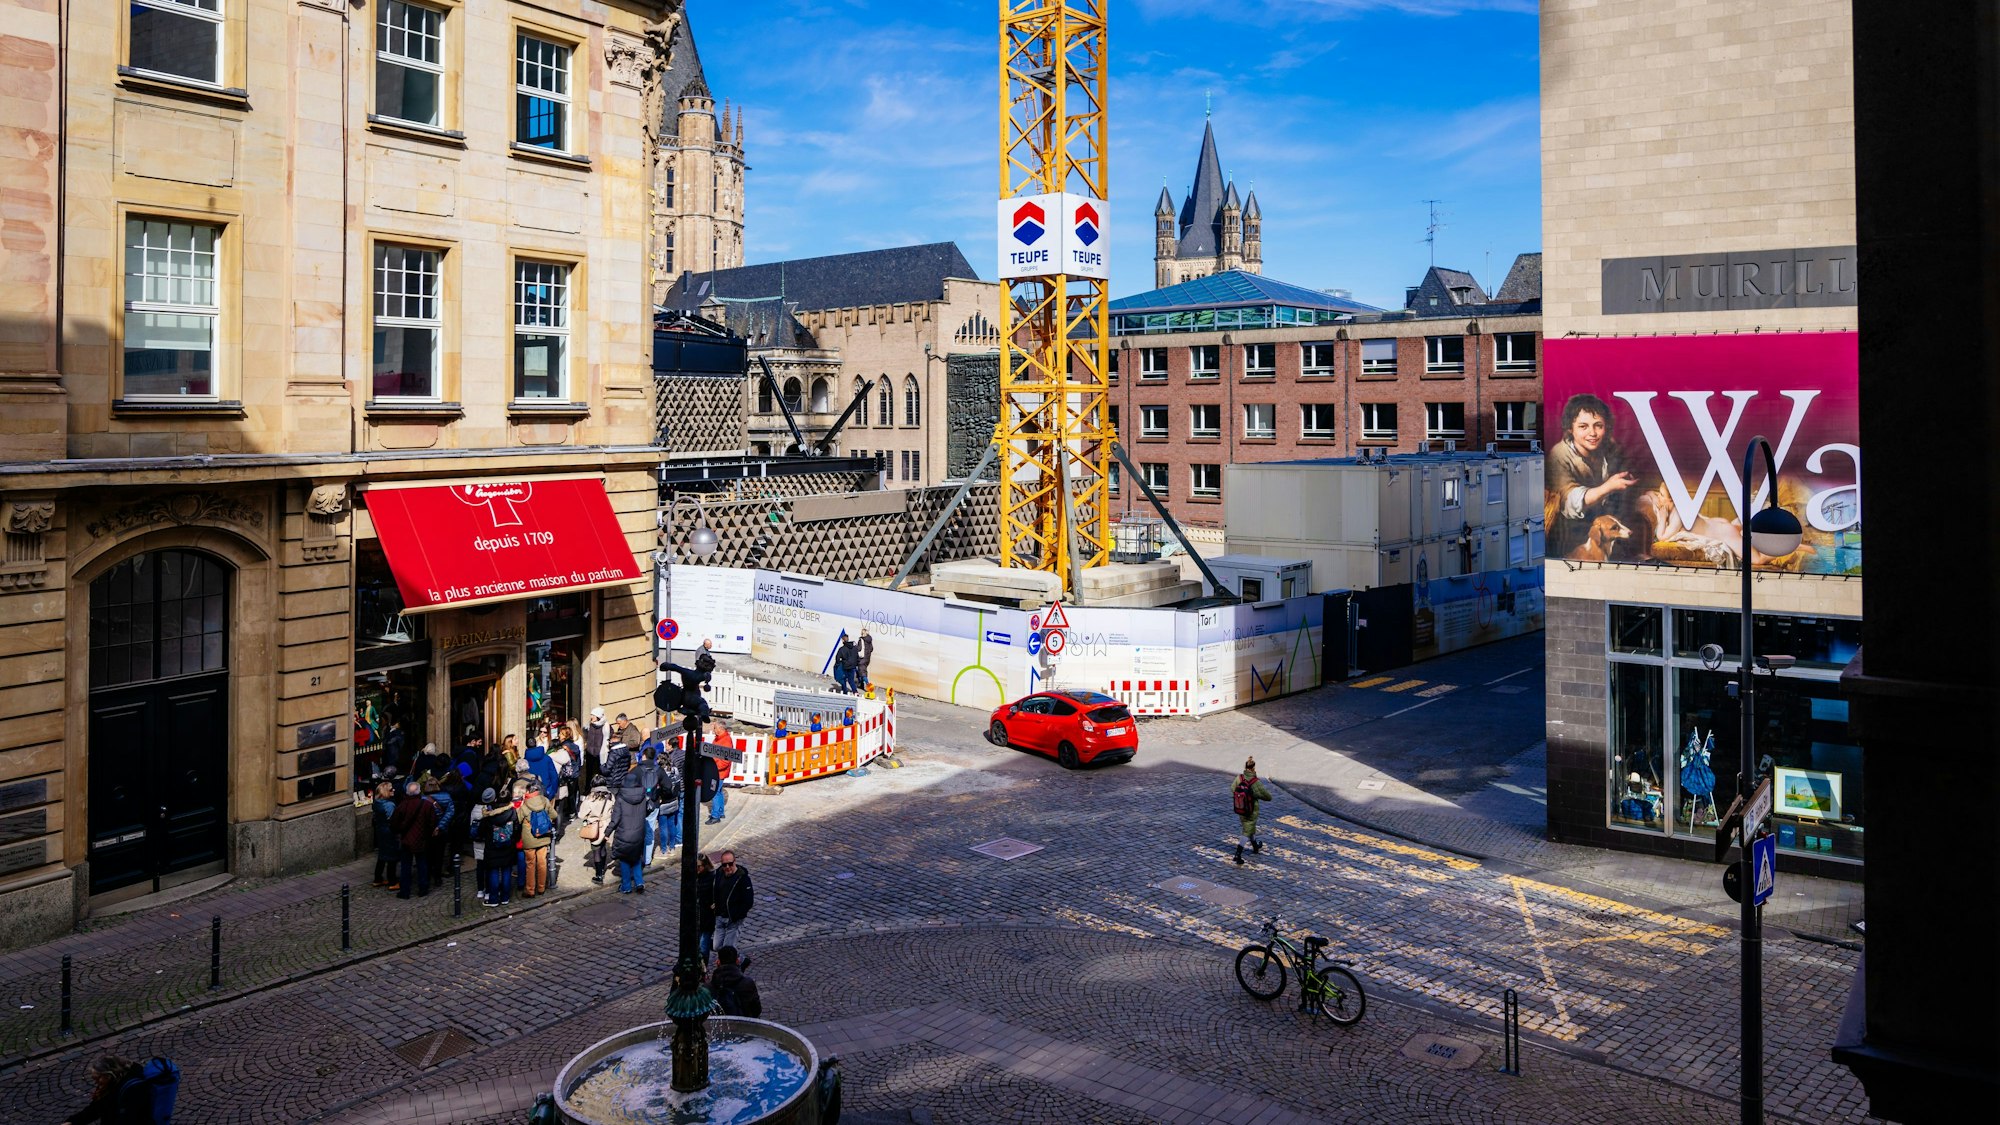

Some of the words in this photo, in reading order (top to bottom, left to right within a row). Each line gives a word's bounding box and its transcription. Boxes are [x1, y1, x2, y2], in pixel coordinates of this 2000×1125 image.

[1010, 249, 1049, 265] TEUPE
[1072, 250, 1102, 265] TEUPE
[1613, 390, 1861, 532] Wa
[474, 534, 520, 552] depuis
[524, 531, 554, 546] 1709
[428, 589, 441, 602] la
[444, 585, 471, 602] plus
[474, 581, 526, 596] ancienne
[529, 574, 568, 588] maison
[570, 571, 585, 583] du
[588, 567, 624, 584] parfum
[758, 583, 775, 592] AUF
[776, 586, 789, 596] EIN
[791, 588, 808, 599] ORT
[757, 593, 785, 605] UNTER
[786, 599, 806, 609] UNS.
[757, 603, 767, 613] IM
[768, 605, 797, 619] DIALOG
[799, 609, 821, 623] ÜBER
[859, 608, 905, 627] MIQUA
[1200, 614, 1211, 625] Tor
[1213, 612, 1217, 624] 1
[756, 613, 772, 624] DAS
[773, 616, 804, 630] MIQUA.
[443, 630, 491, 649] FARINA
[1052, 636, 1058, 648] 5
[310, 676, 321, 687] 21
